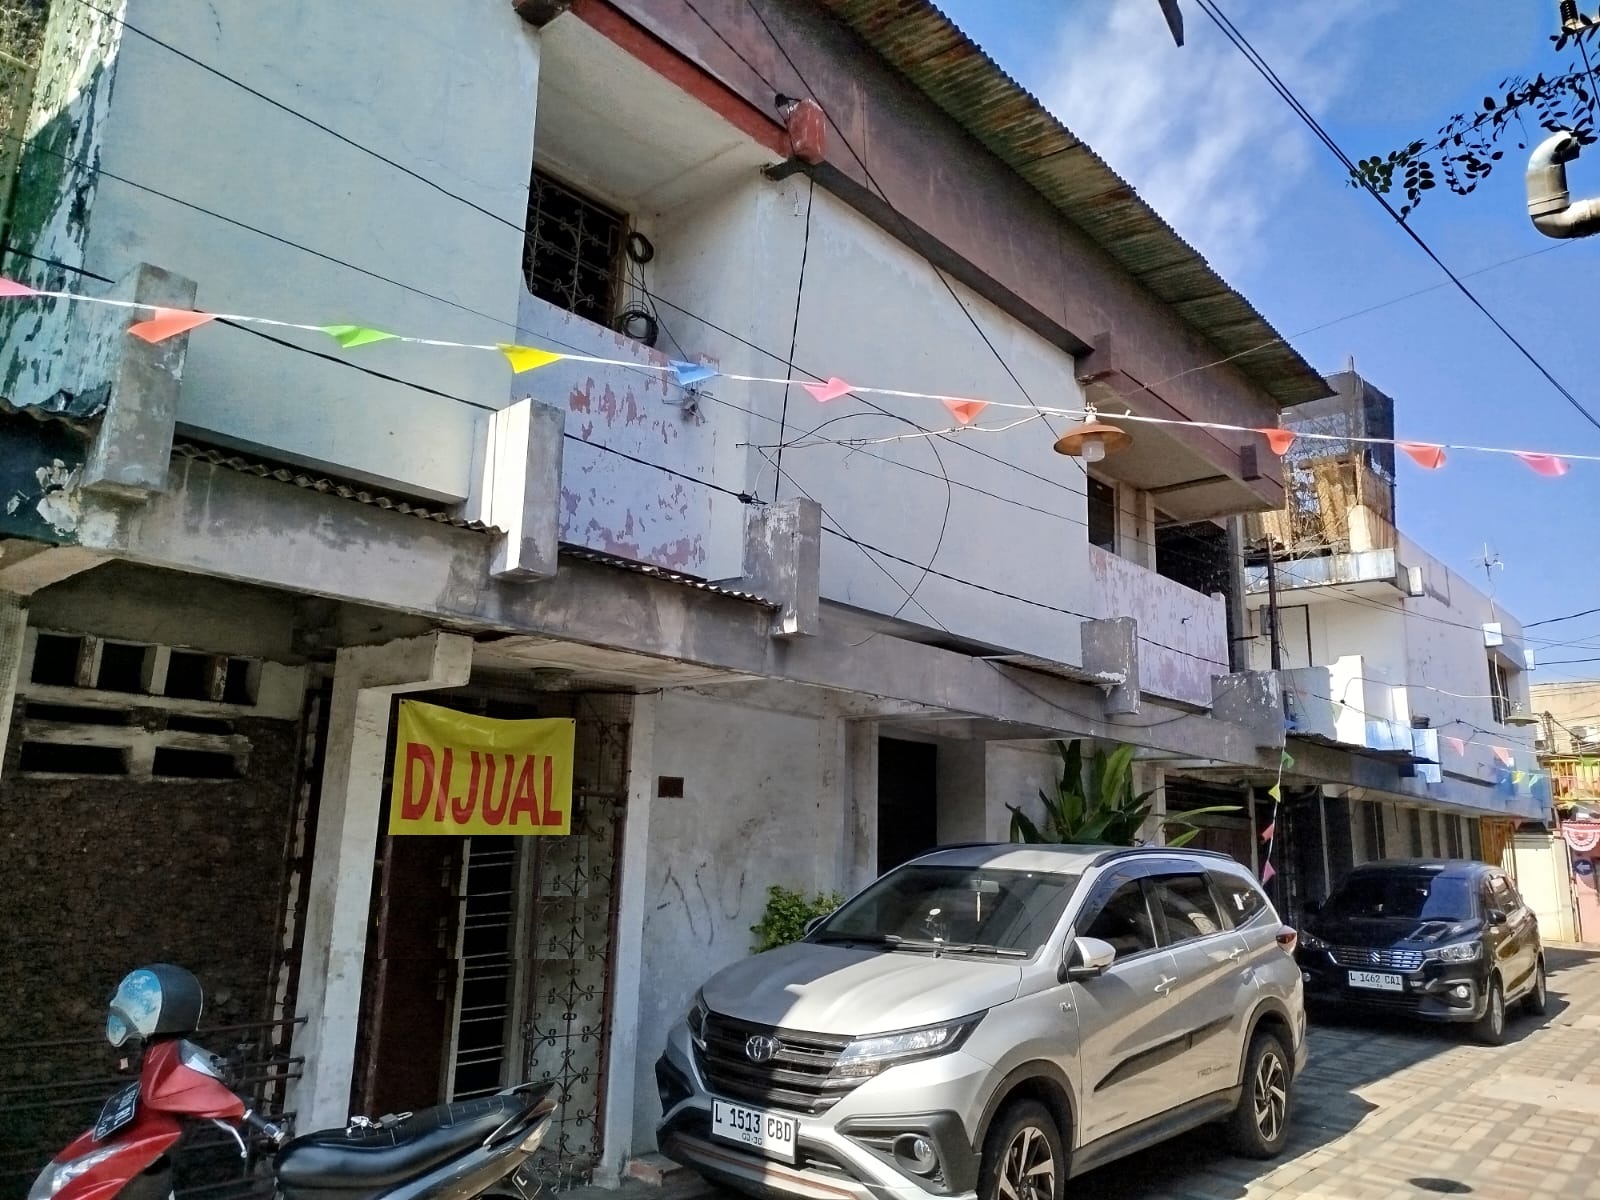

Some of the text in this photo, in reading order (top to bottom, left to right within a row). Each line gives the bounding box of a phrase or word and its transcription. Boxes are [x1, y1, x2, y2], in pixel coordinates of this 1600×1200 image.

[401, 742, 562, 826] DIJUAL
[1349, 972, 1356, 981] L
[1359, 973, 1381, 983] 1462
[715, 1103, 792, 1143] L 1513 CBD
